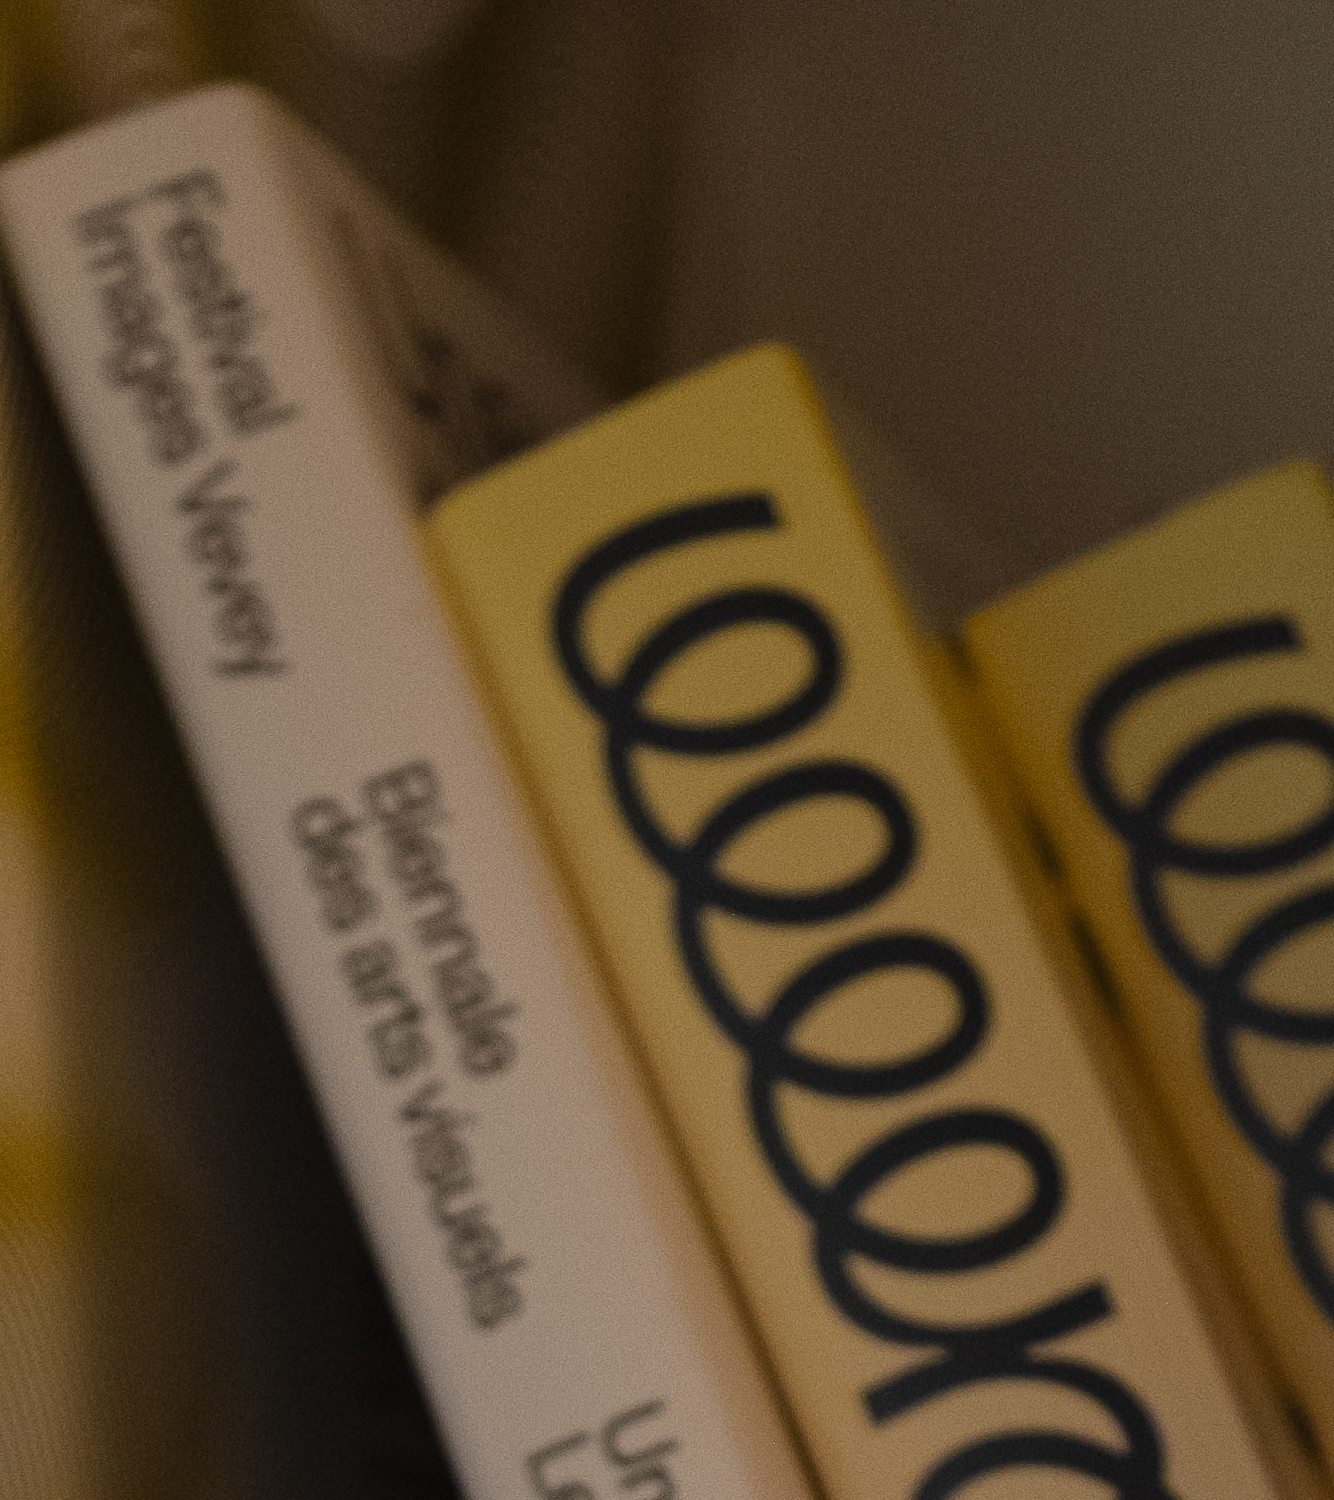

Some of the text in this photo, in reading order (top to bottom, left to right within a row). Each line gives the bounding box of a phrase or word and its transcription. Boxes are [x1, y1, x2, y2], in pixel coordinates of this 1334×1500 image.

[75, 198, 295, 680] Images Vevey
[143, 168, 299, 439] Festival
[289, 794, 530, 1332] des arts visuels
[361, 757, 521, 1082] Biennale
